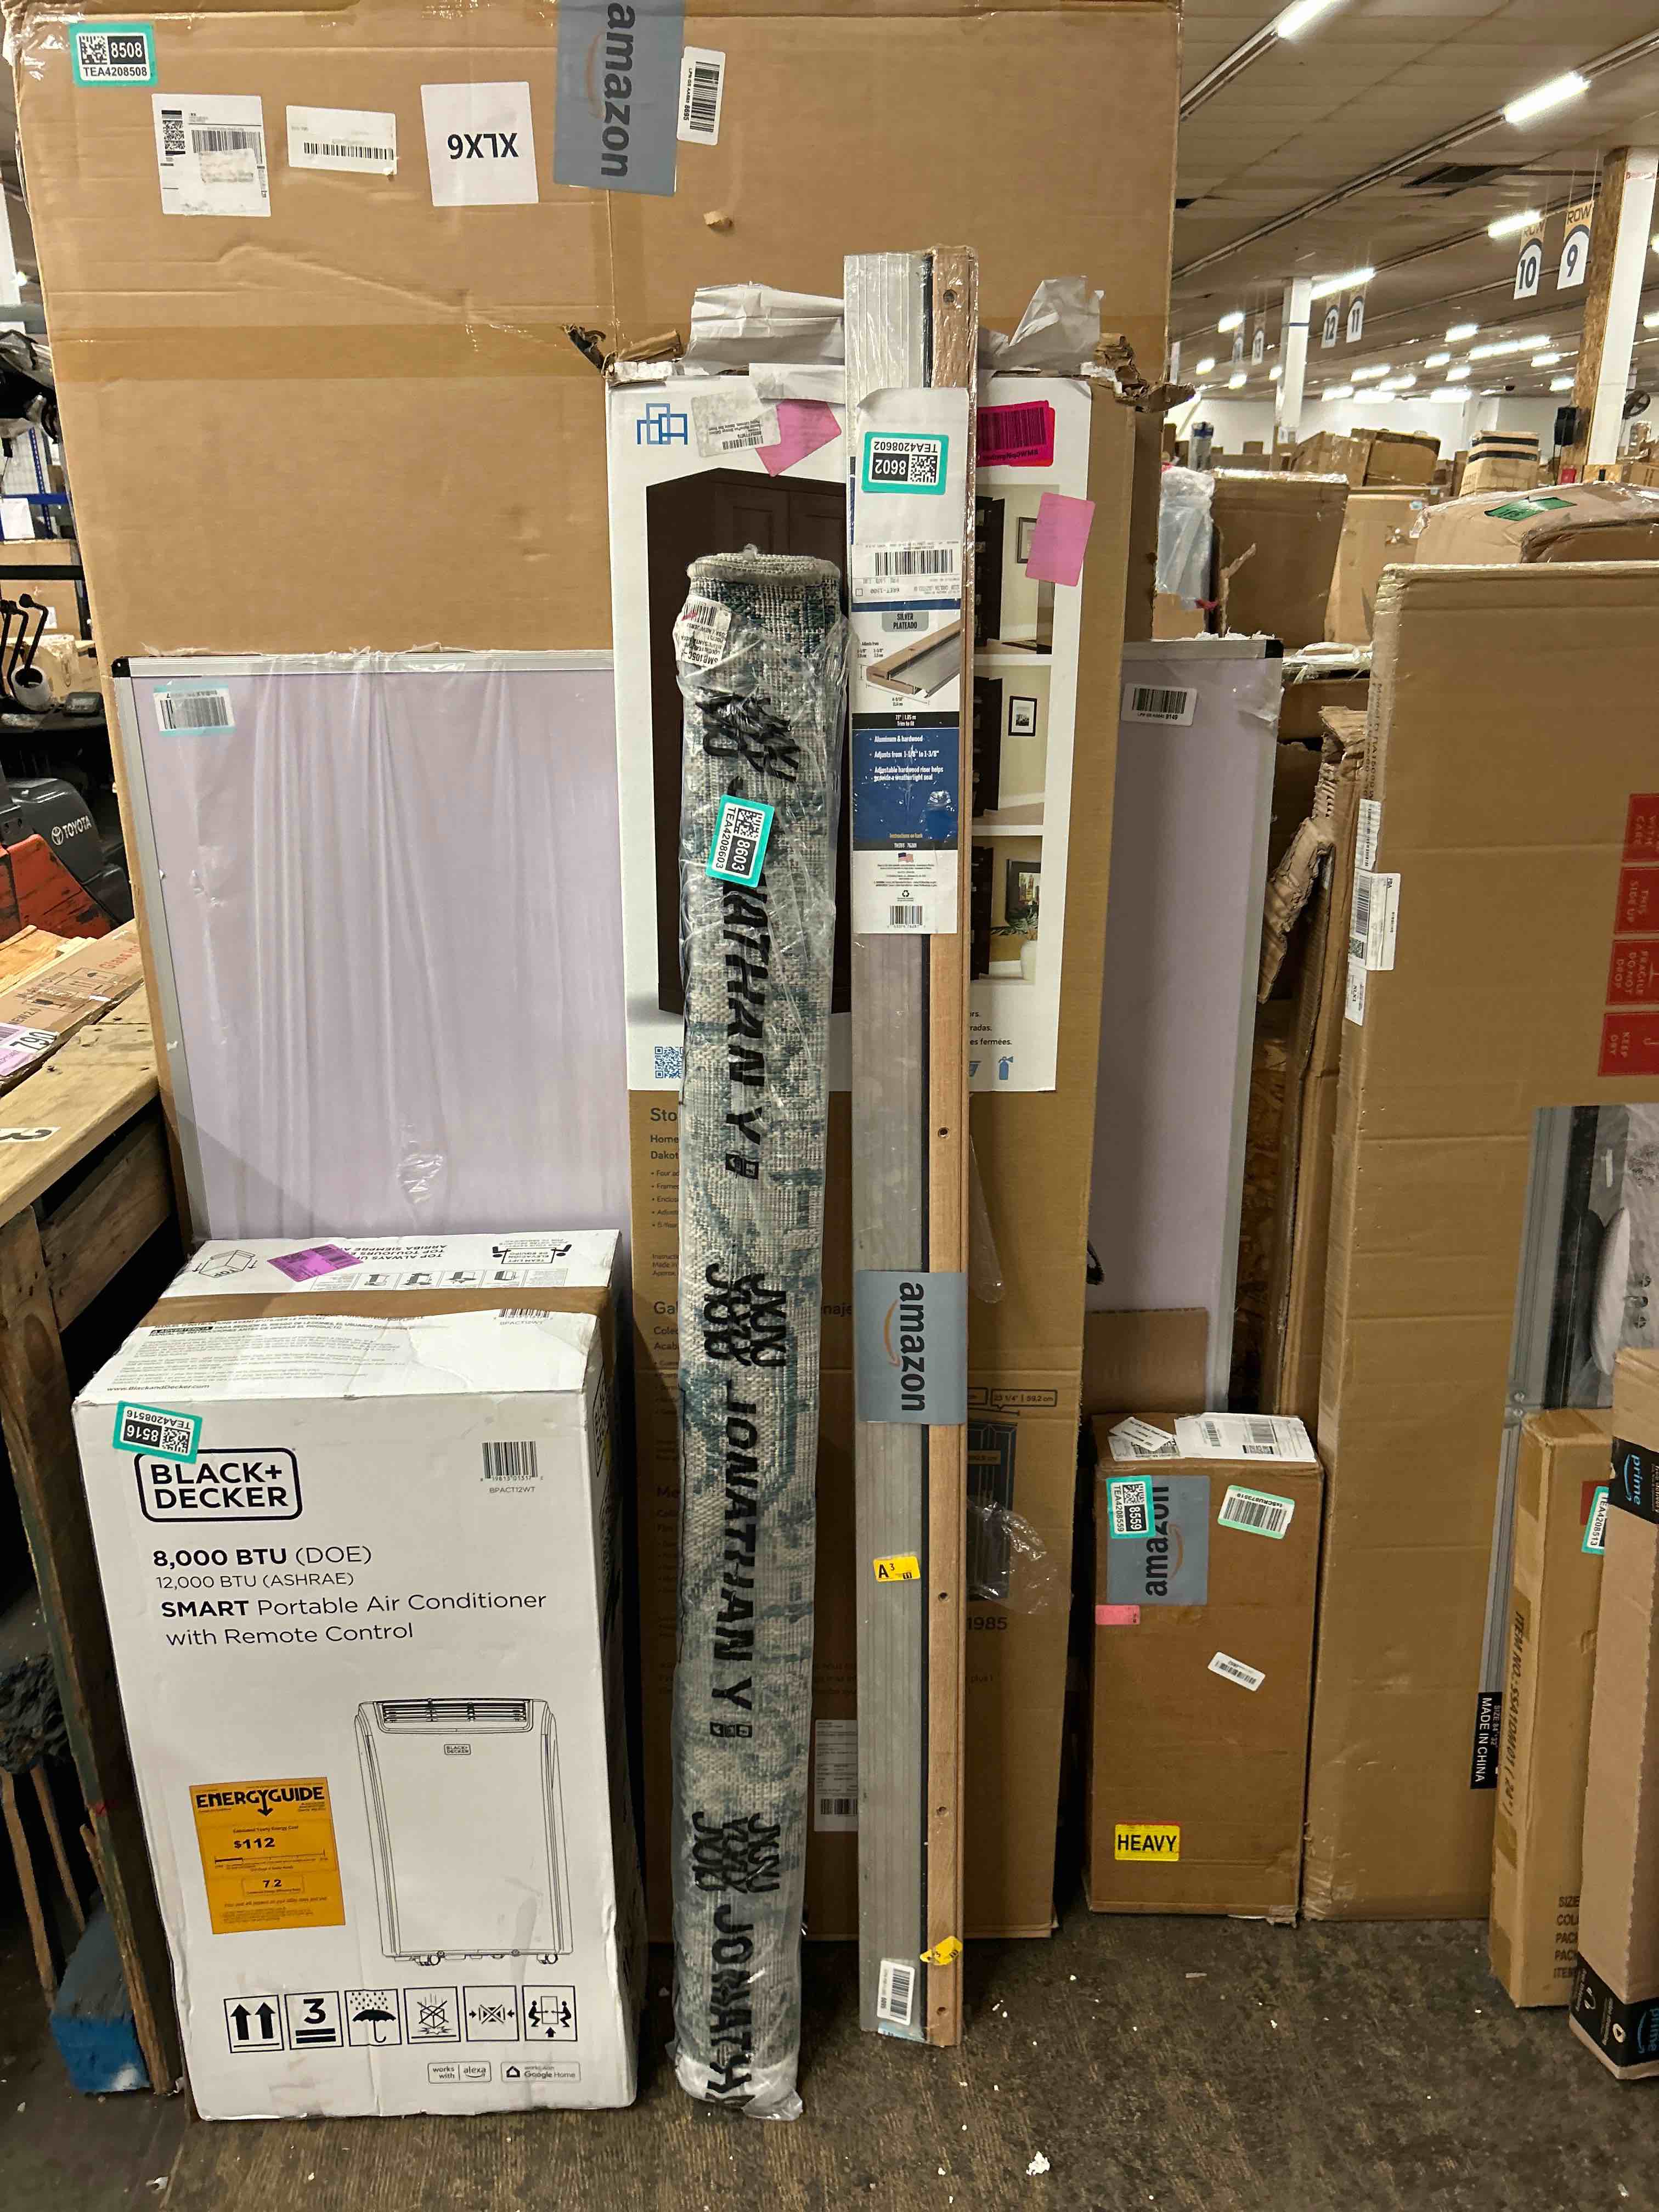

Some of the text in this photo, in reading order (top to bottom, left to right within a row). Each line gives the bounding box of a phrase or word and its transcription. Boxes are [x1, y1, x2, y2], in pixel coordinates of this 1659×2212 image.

[111, 42, 143, 59] 8508
[83, 65, 147, 78] TEA4208508
[601, 3, 635, 177] amazon
[1567, 206, 1591, 225] ROW
[1519, 257, 1537, 289] 10
[1567, 245, 1578, 277] 9
[1325, 317, 1336, 340] 12
[1352, 308, 1361, 332] 11
[874, 441, 938, 453] TEA4208602
[874, 459, 906, 476] 8602
[63, 816, 92, 838] TOYOTA
[715, 808, 737, 870] TEA4208603
[1633, 816, 1644, 846] CARE
[732, 838, 751, 872] 8603
[1626, 881, 1639, 923] SIDE UP
[1639, 890, 1649, 915] THIS
[1614, 958, 1624, 989] DROP
[1624, 952, 1637, 995] DO NOT
[1635, 950, 1649, 996] FRAGILE
[1609, 1034, 1619, 1055] DRY
[1620, 1031, 1631, 1058] KEEP
[725, 1107, 763, 1146] Y
[899, 1282, 926, 1410] amazon
[126, 1409, 191, 1429] TEA4208516
[126, 1425, 159, 1442] 8516
[150, 1462, 282, 1485] BLACK+
[1630, 1454, 1644, 1506] prime
[154, 1486, 289, 1509] DECKER
[1115, 1485, 1125, 1532] TEA4208559
[1128, 1505, 1143, 1531] 8559
[1589, 1496, 1609, 1547] TEA4208513
[153, 1546, 372, 1569] 8,000 BTU (DOE)
[711, 1379, 758, 1711] JONATHAN Y
[156, 1572, 354, 1590] 12,000 BTU (ASHRAE)
[878, 1564, 889, 1578] A
[161, 1592, 546, 1617] SMART Portable Air Conditioner
[166, 1622, 413, 1646] with Remote Control
[1513, 1612, 1525, 1651] ITEM
[1474, 1697, 1492, 1782] MADE IN CHINA
[195, 1786, 325, 1809] ENERGYGUIDE
[233, 1837, 275, 1849] $112
[1117, 1833, 1177, 1852] HEAVY
[303, 1997, 326, 2025] 3
[464, 2066, 486, 2074] alexa
